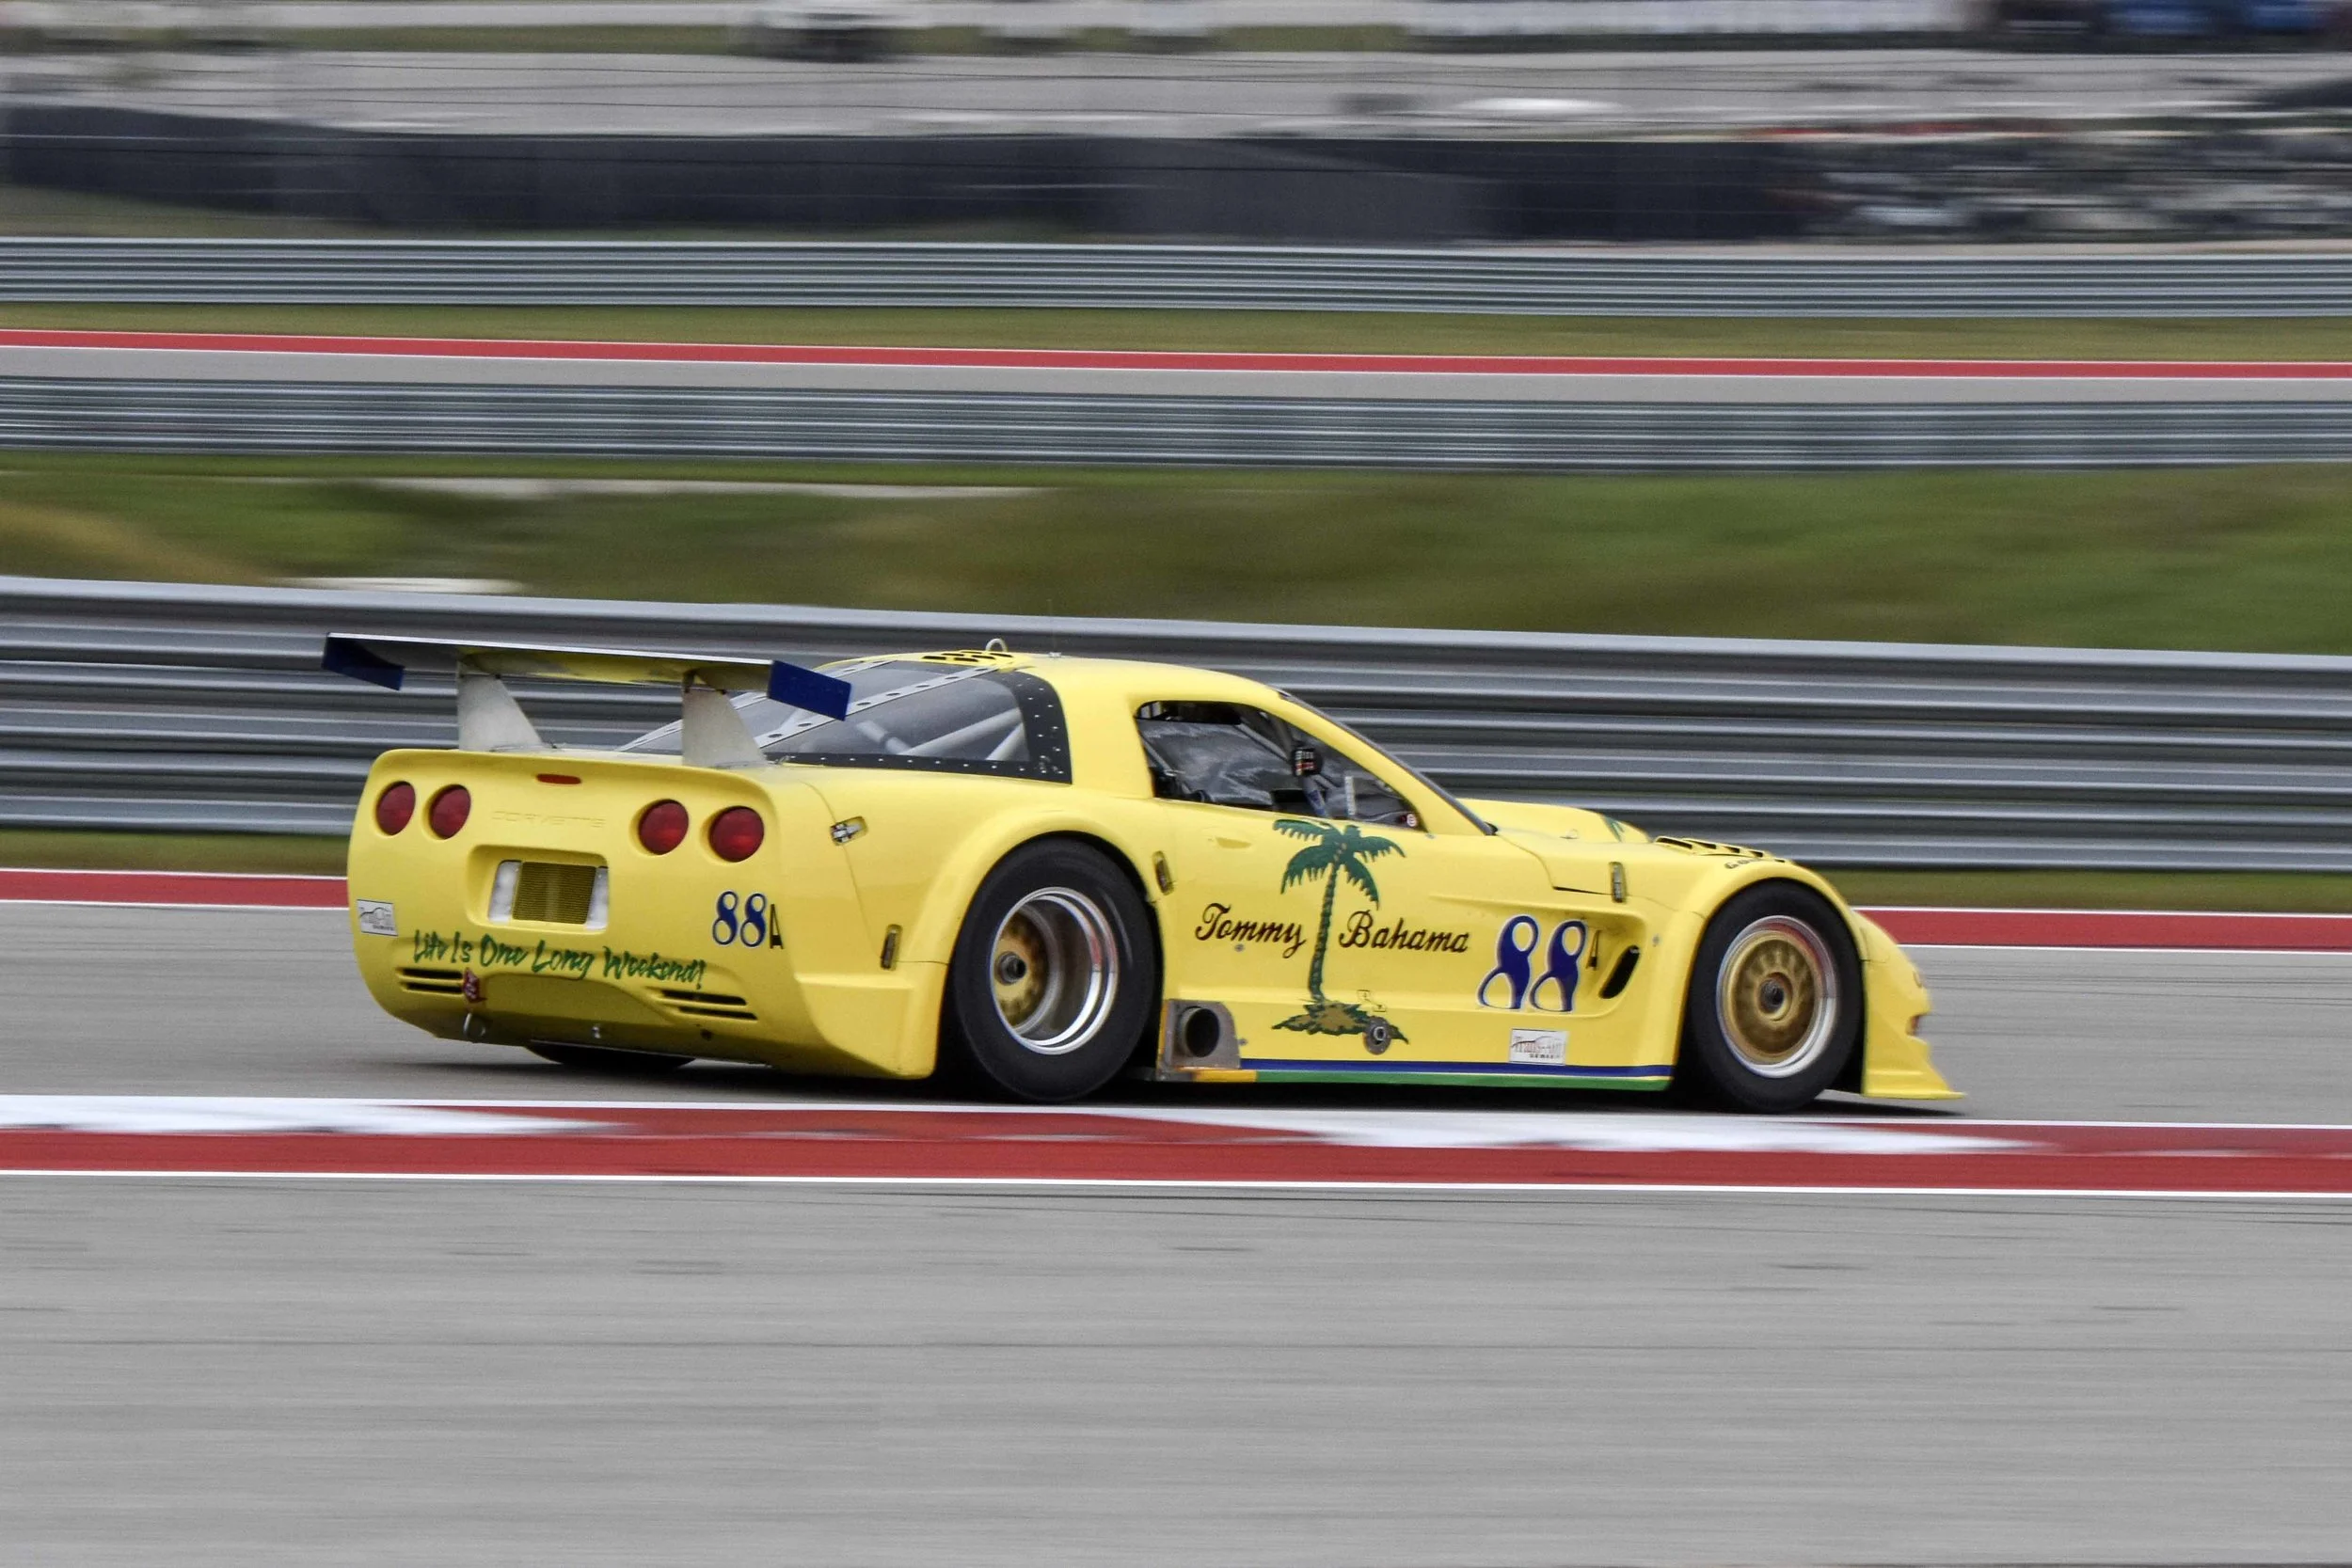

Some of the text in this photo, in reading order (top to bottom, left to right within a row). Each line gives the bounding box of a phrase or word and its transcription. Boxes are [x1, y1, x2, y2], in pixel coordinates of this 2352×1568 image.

[1195, 902, 1470, 958] Tommy Bahama
[451, 931, 472, 963] Is
[480, 933, 528, 967] One
[532, 940, 595, 980] Long
[603, 945, 707, 990] Weekend!
